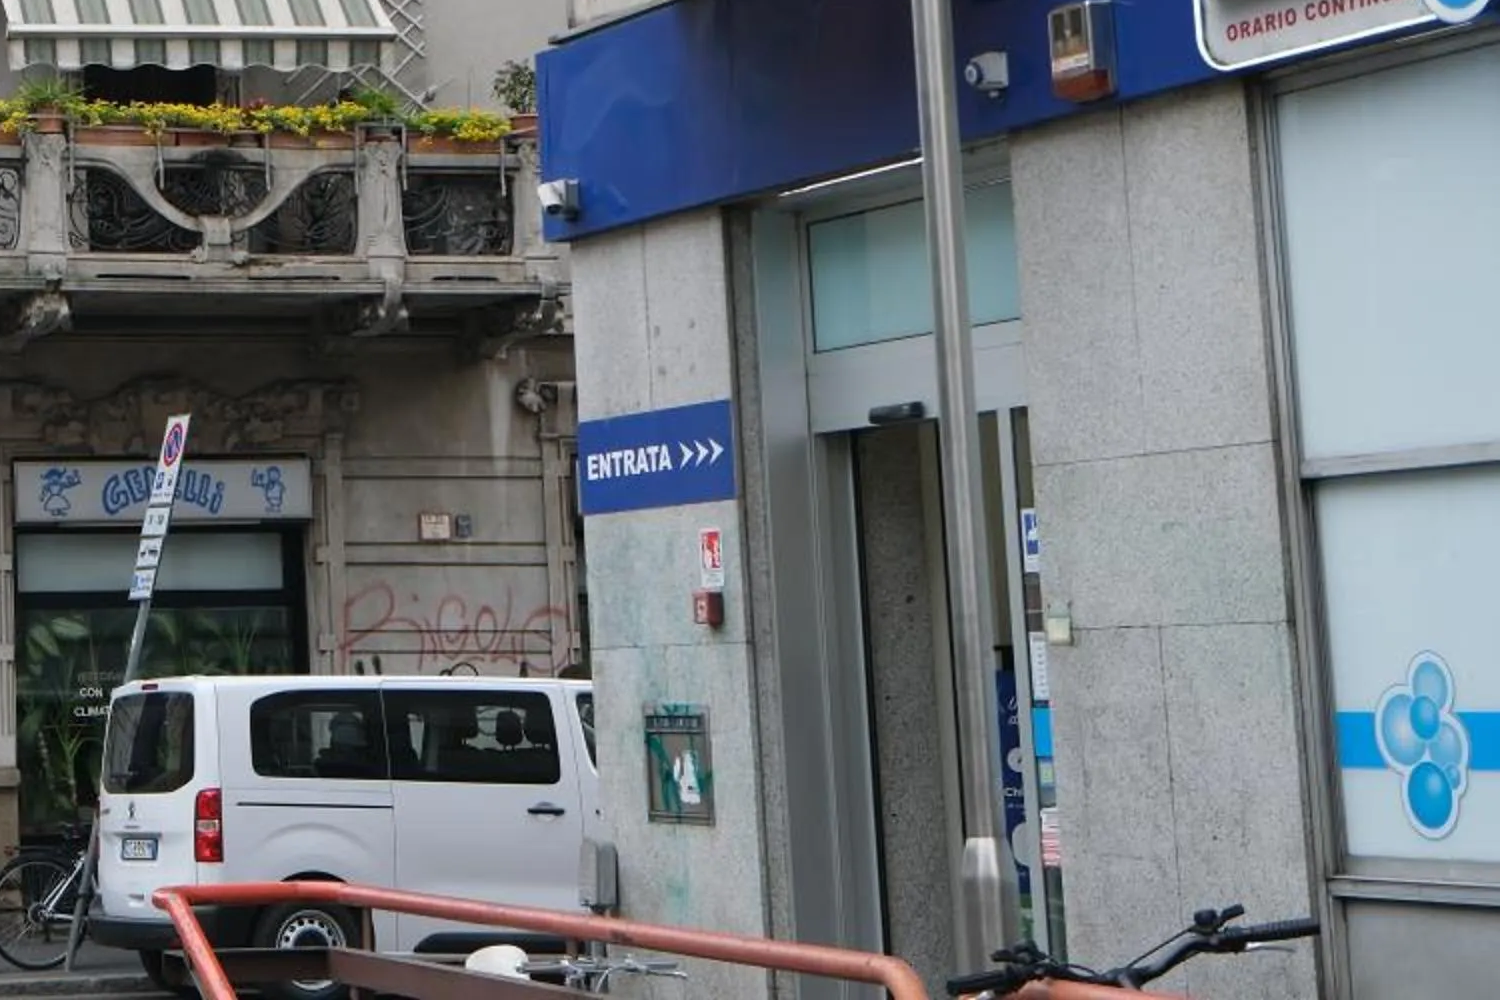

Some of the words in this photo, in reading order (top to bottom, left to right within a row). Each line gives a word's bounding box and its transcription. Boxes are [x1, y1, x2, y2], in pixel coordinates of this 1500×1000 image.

[1227, 8, 1297, 42] ORARIO
[587, 444, 672, 481] ENTRATA
[79, 687, 103, 698] CON
